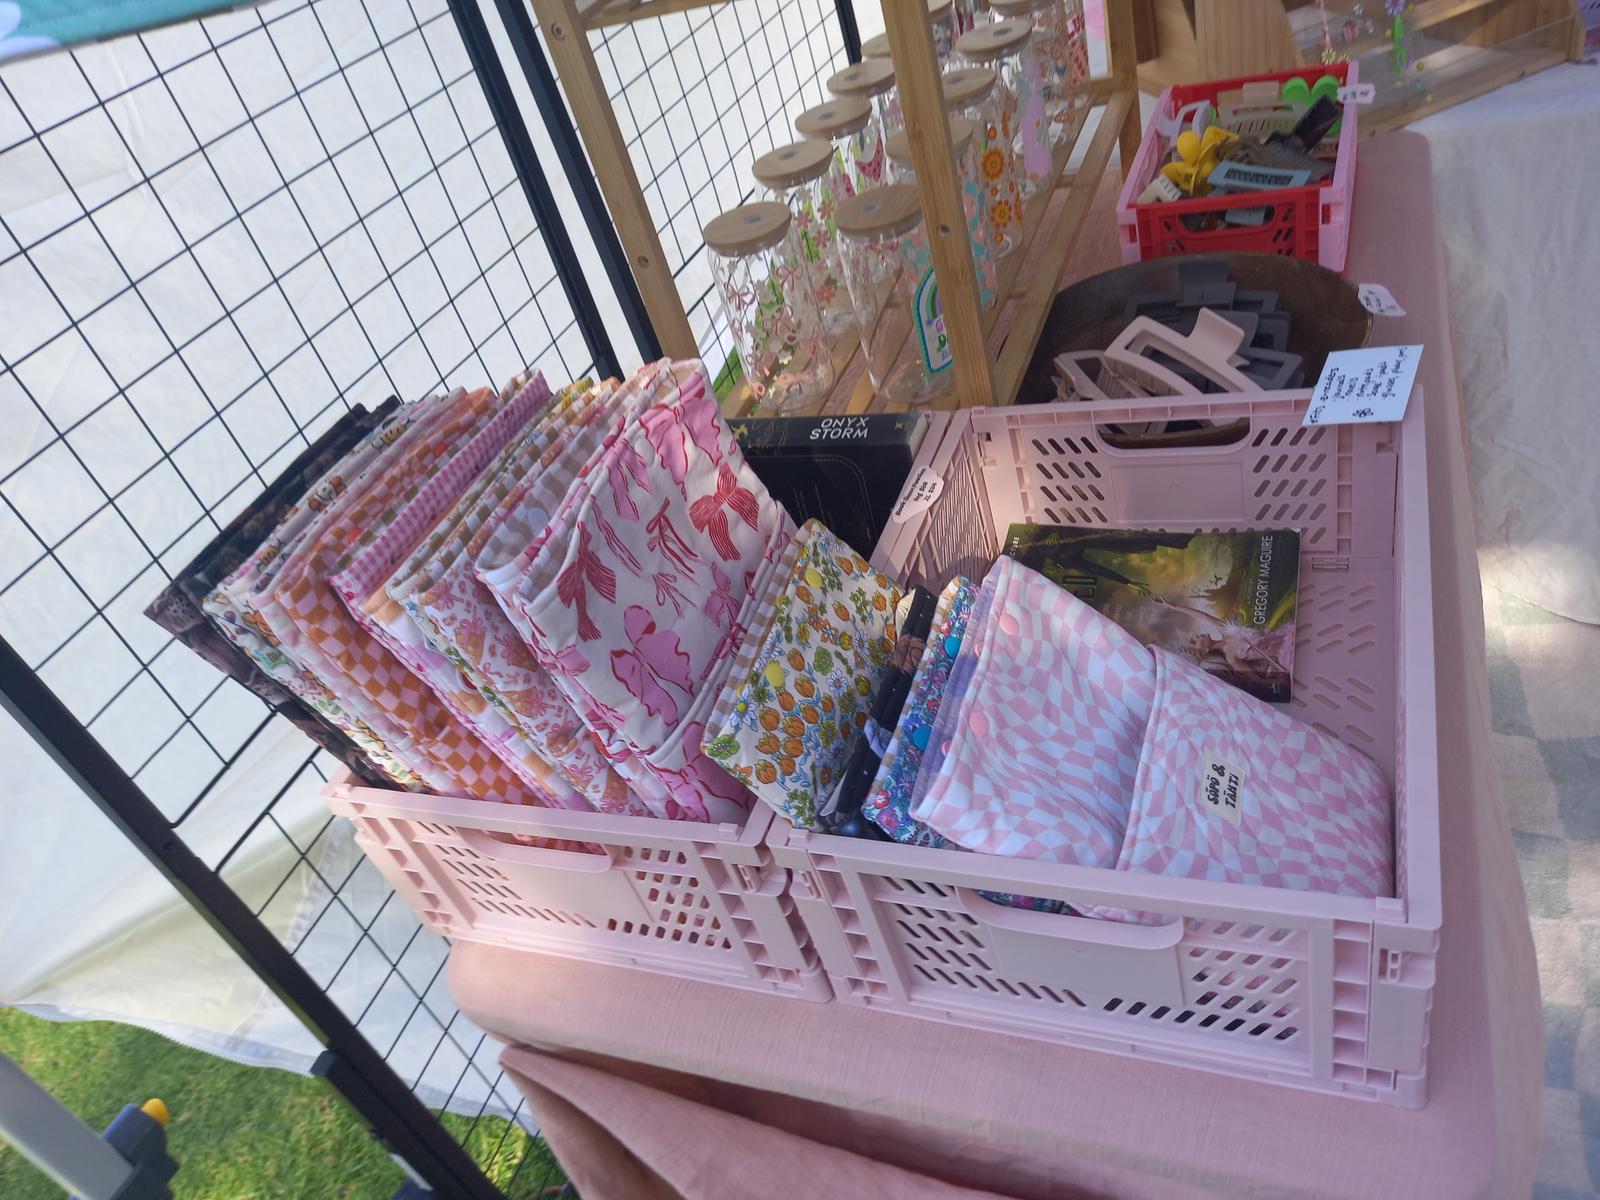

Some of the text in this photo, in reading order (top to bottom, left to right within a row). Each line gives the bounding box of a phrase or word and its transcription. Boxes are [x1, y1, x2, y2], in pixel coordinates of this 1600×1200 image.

[810, 427, 869, 440] STORM
[820, 416, 870, 428] ONYX
[1253, 535, 1274, 625] GREGORY MAGUIRE
[1205, 763, 1226, 805] SÖPÖ &
